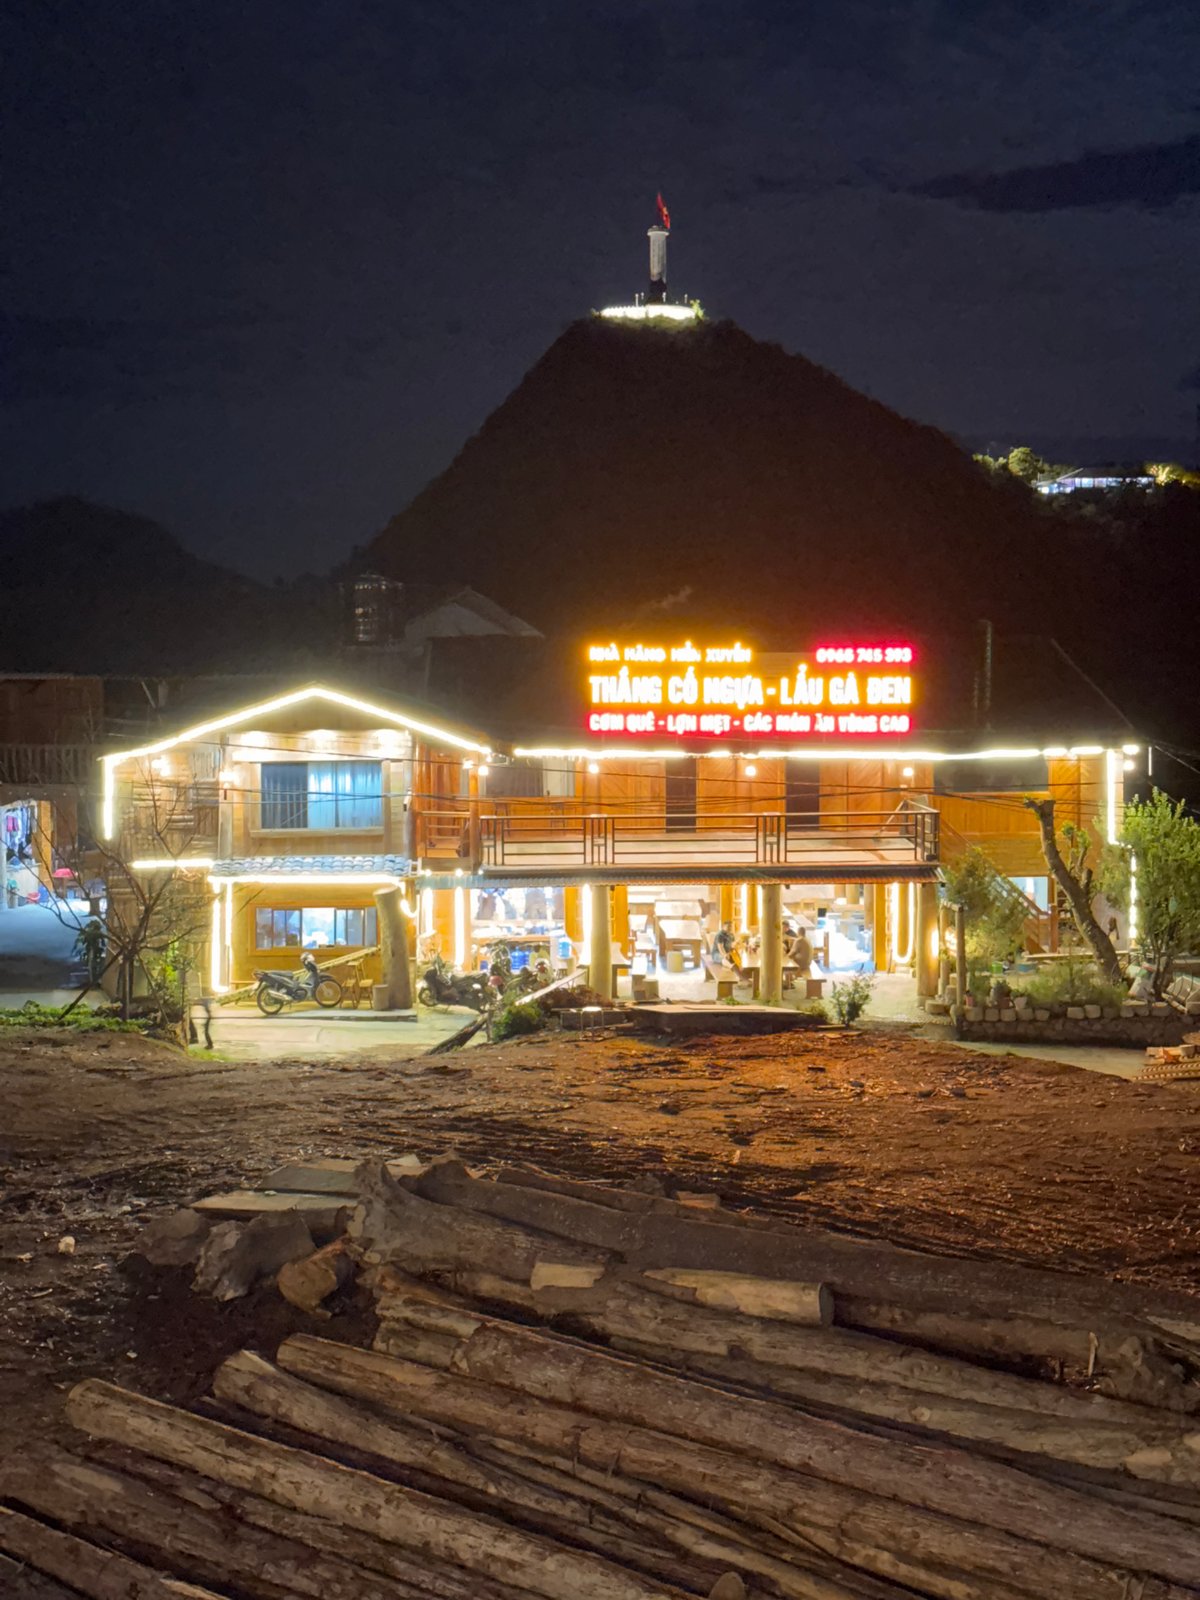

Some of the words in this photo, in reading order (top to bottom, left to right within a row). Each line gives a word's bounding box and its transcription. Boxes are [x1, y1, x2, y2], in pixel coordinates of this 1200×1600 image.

[829, 672, 859, 705] GÀ
[743, 712, 772, 732] CÁC
[879, 715, 910, 733] CAO
